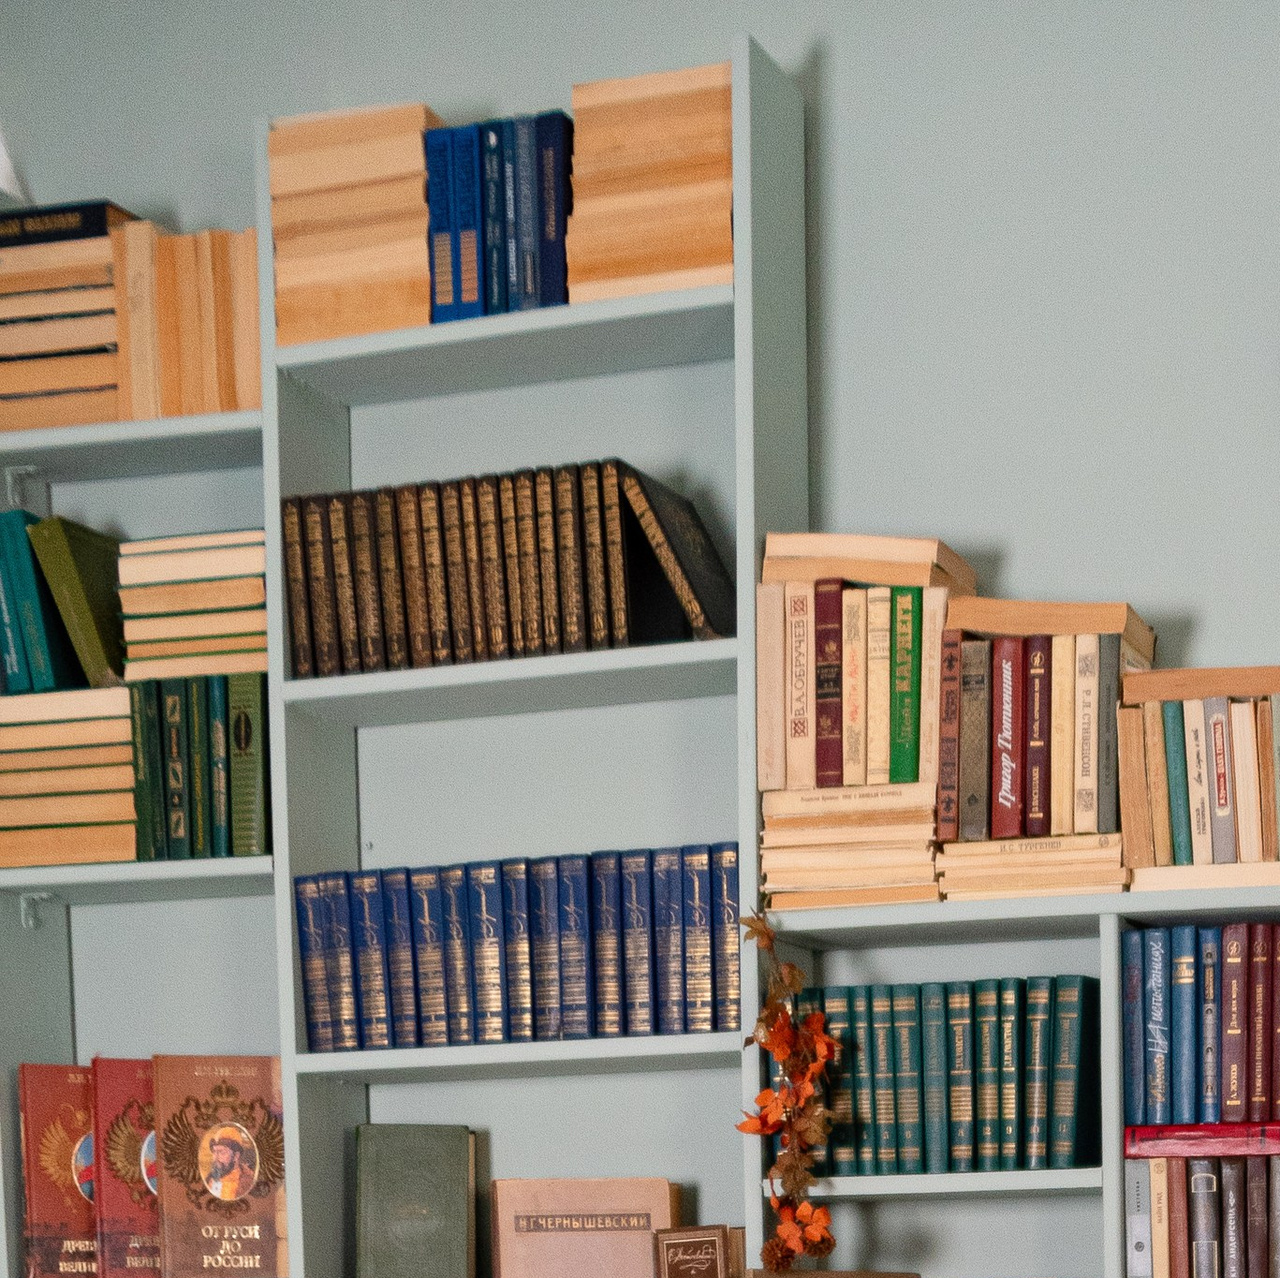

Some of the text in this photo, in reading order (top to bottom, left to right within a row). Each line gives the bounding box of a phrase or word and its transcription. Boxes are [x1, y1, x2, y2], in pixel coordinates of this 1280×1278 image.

[793, 619, 807, 699] ОБРУЧЕВ
[996, 658, 1016, 808] Григор Тютюнник
[538, 1215, 648, 1230] ЧЕРНЫШЕВСКИЙ
[223, 1225, 260, 1240] РУСИ
[219, 1241, 242, 1255] ДО
[203, 1255, 261, 1268] РОССИИ
